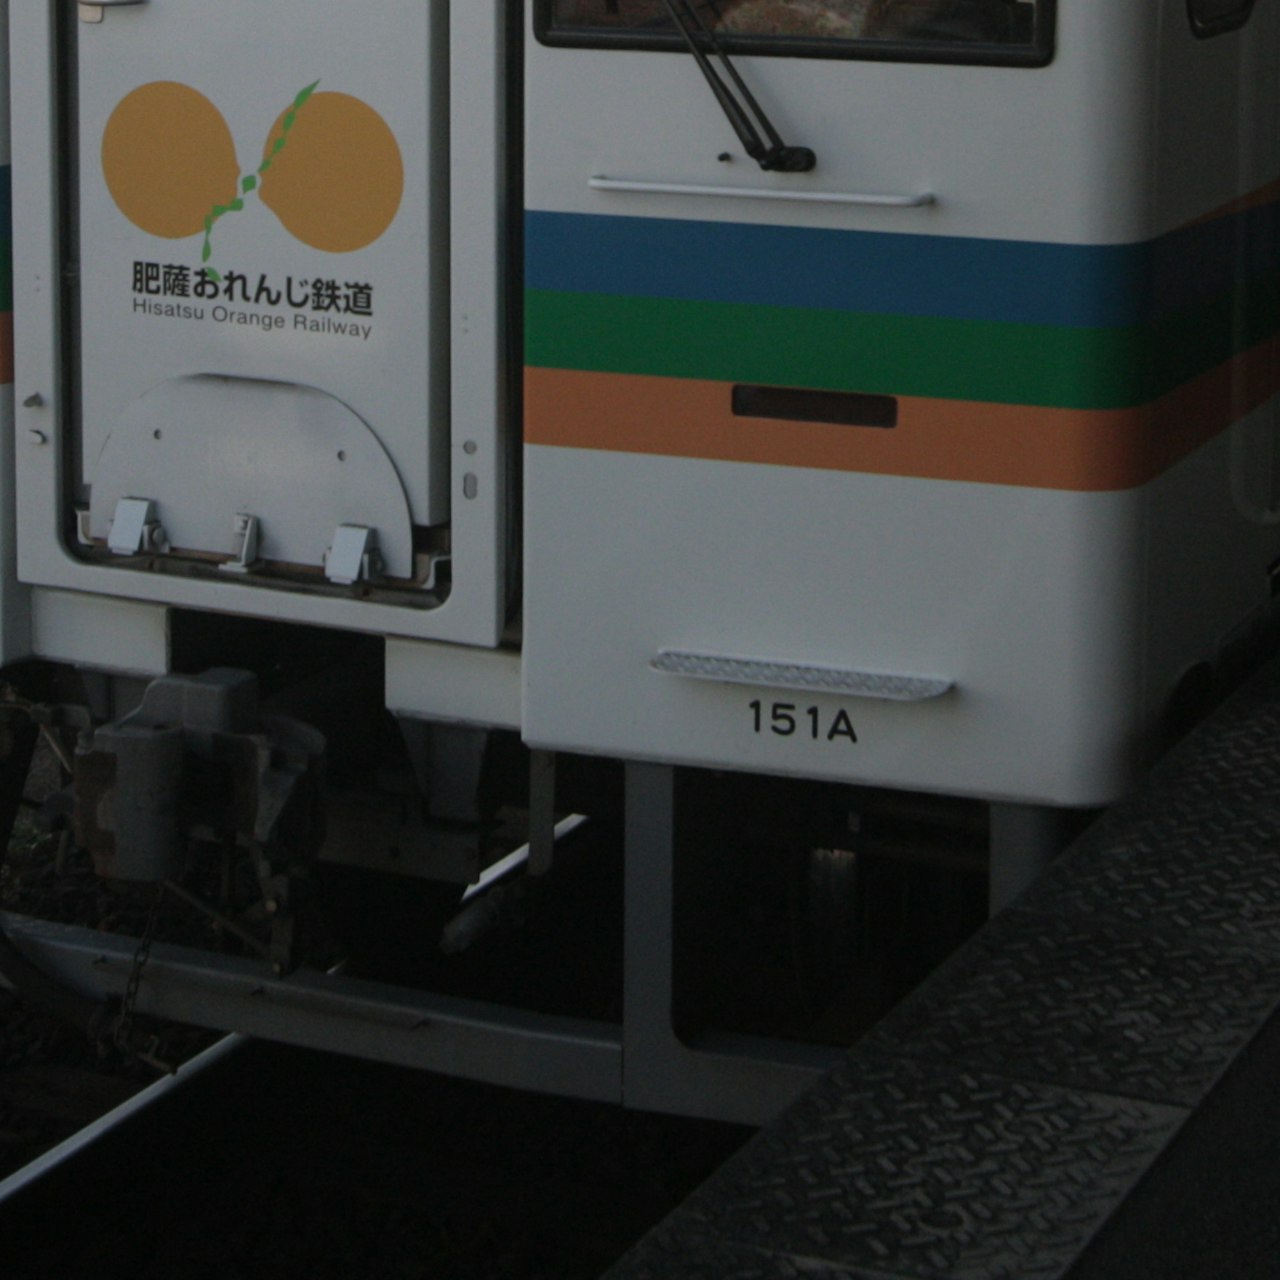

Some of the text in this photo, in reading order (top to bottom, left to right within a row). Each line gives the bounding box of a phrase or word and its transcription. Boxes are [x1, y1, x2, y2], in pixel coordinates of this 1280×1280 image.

[132, 260, 374, 317] 肥薩おれんじ鉄道
[132, 298, 373, 340] Hisatsu Orange Railway
[749, 699, 859, 744] 151A
